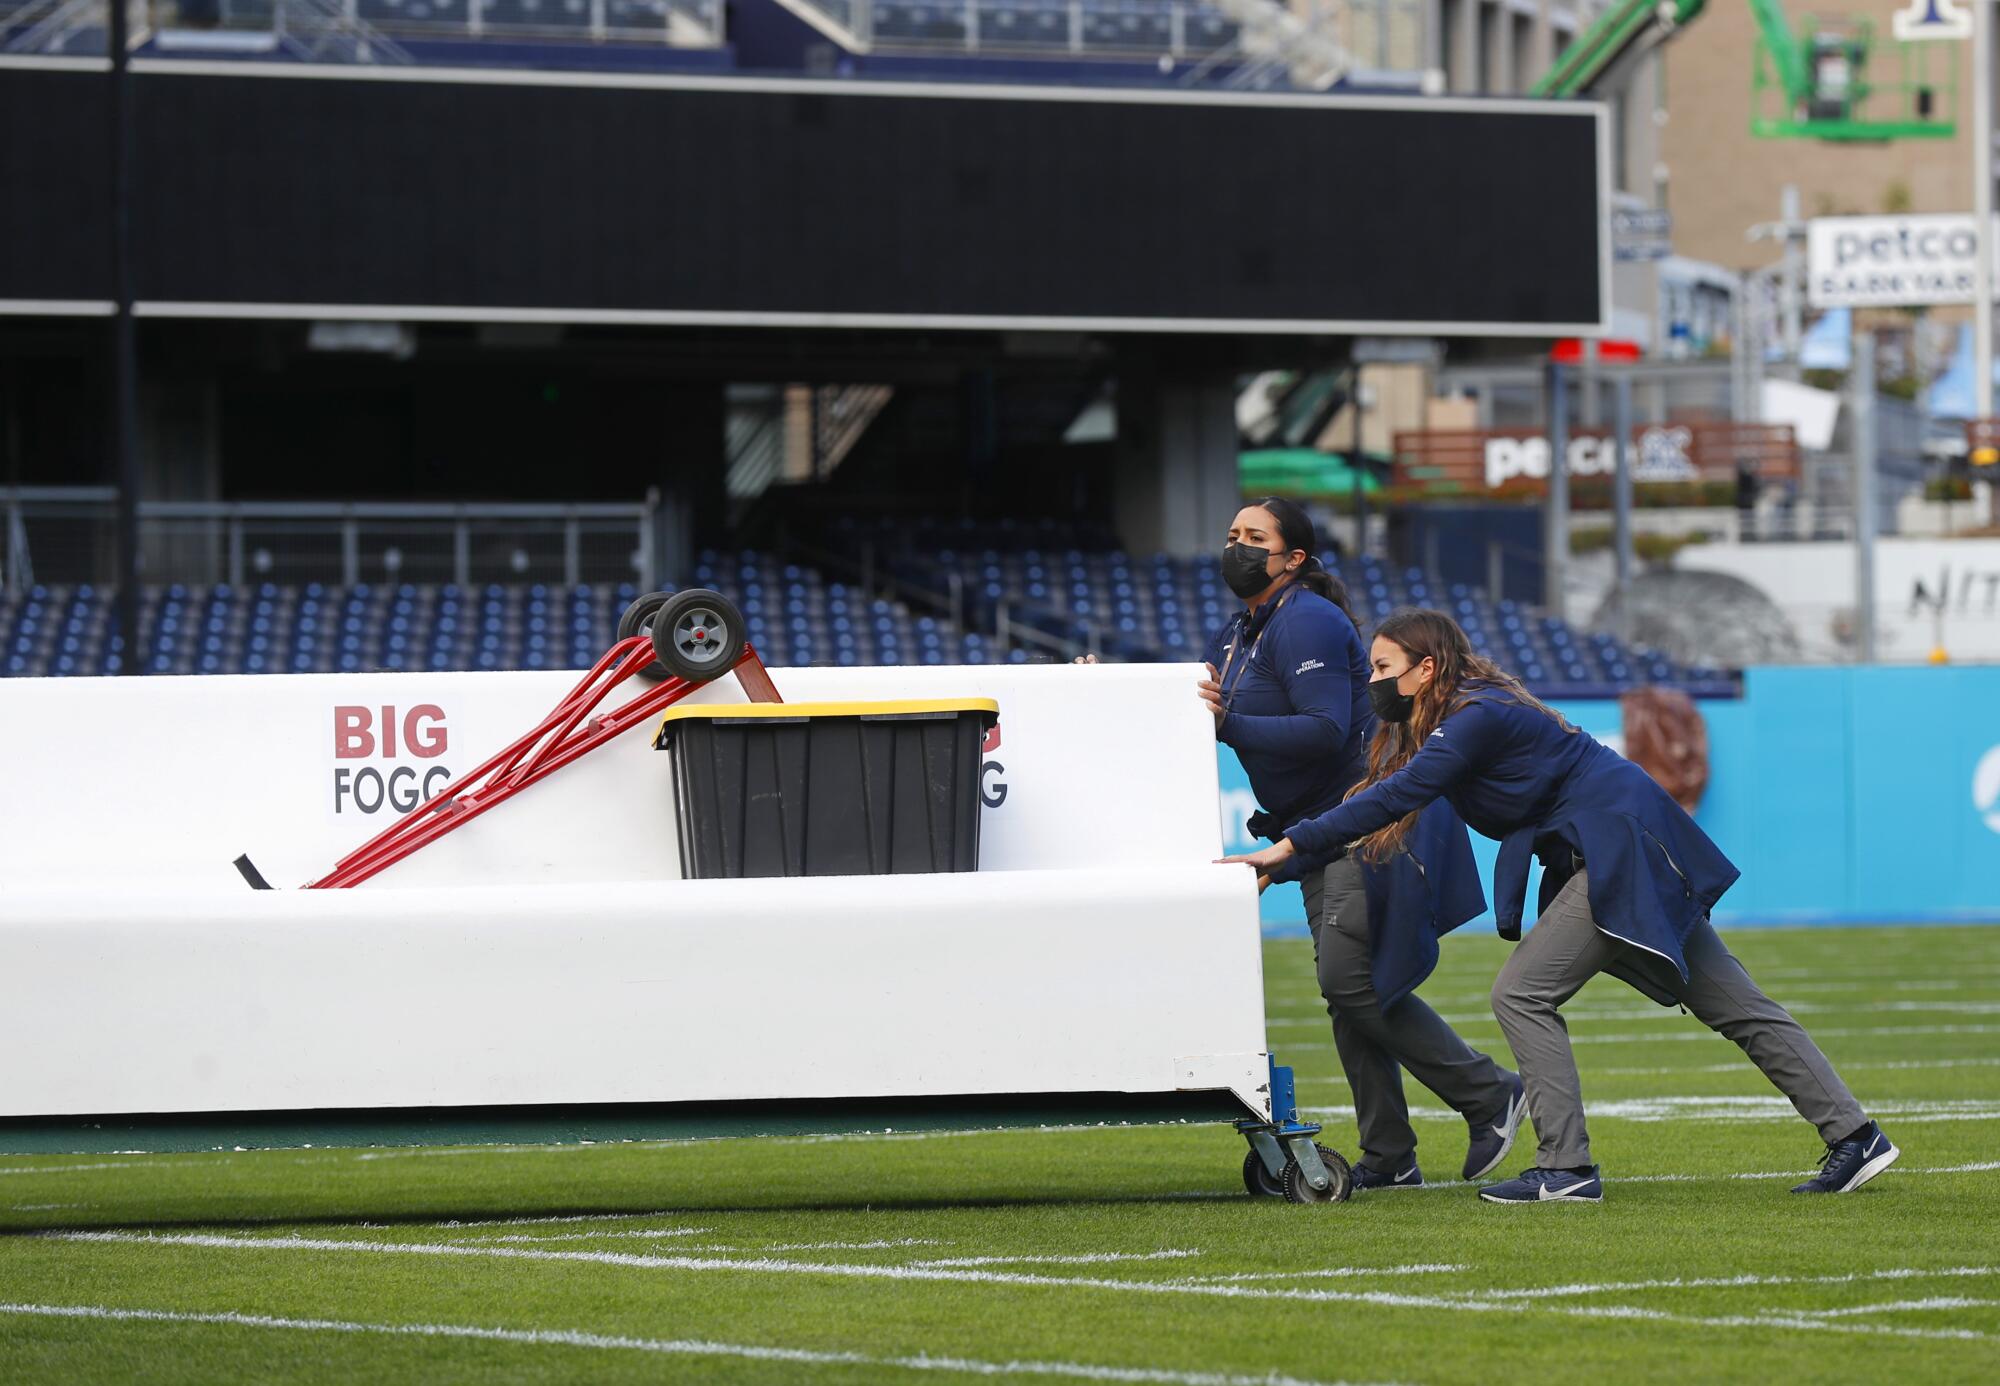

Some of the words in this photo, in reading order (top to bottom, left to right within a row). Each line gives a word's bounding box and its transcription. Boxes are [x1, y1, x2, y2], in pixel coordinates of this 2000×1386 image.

[1836, 229, 1977, 267] petco
[1485, 435, 1637, 488] peco
[334, 704, 448, 759] BIG
